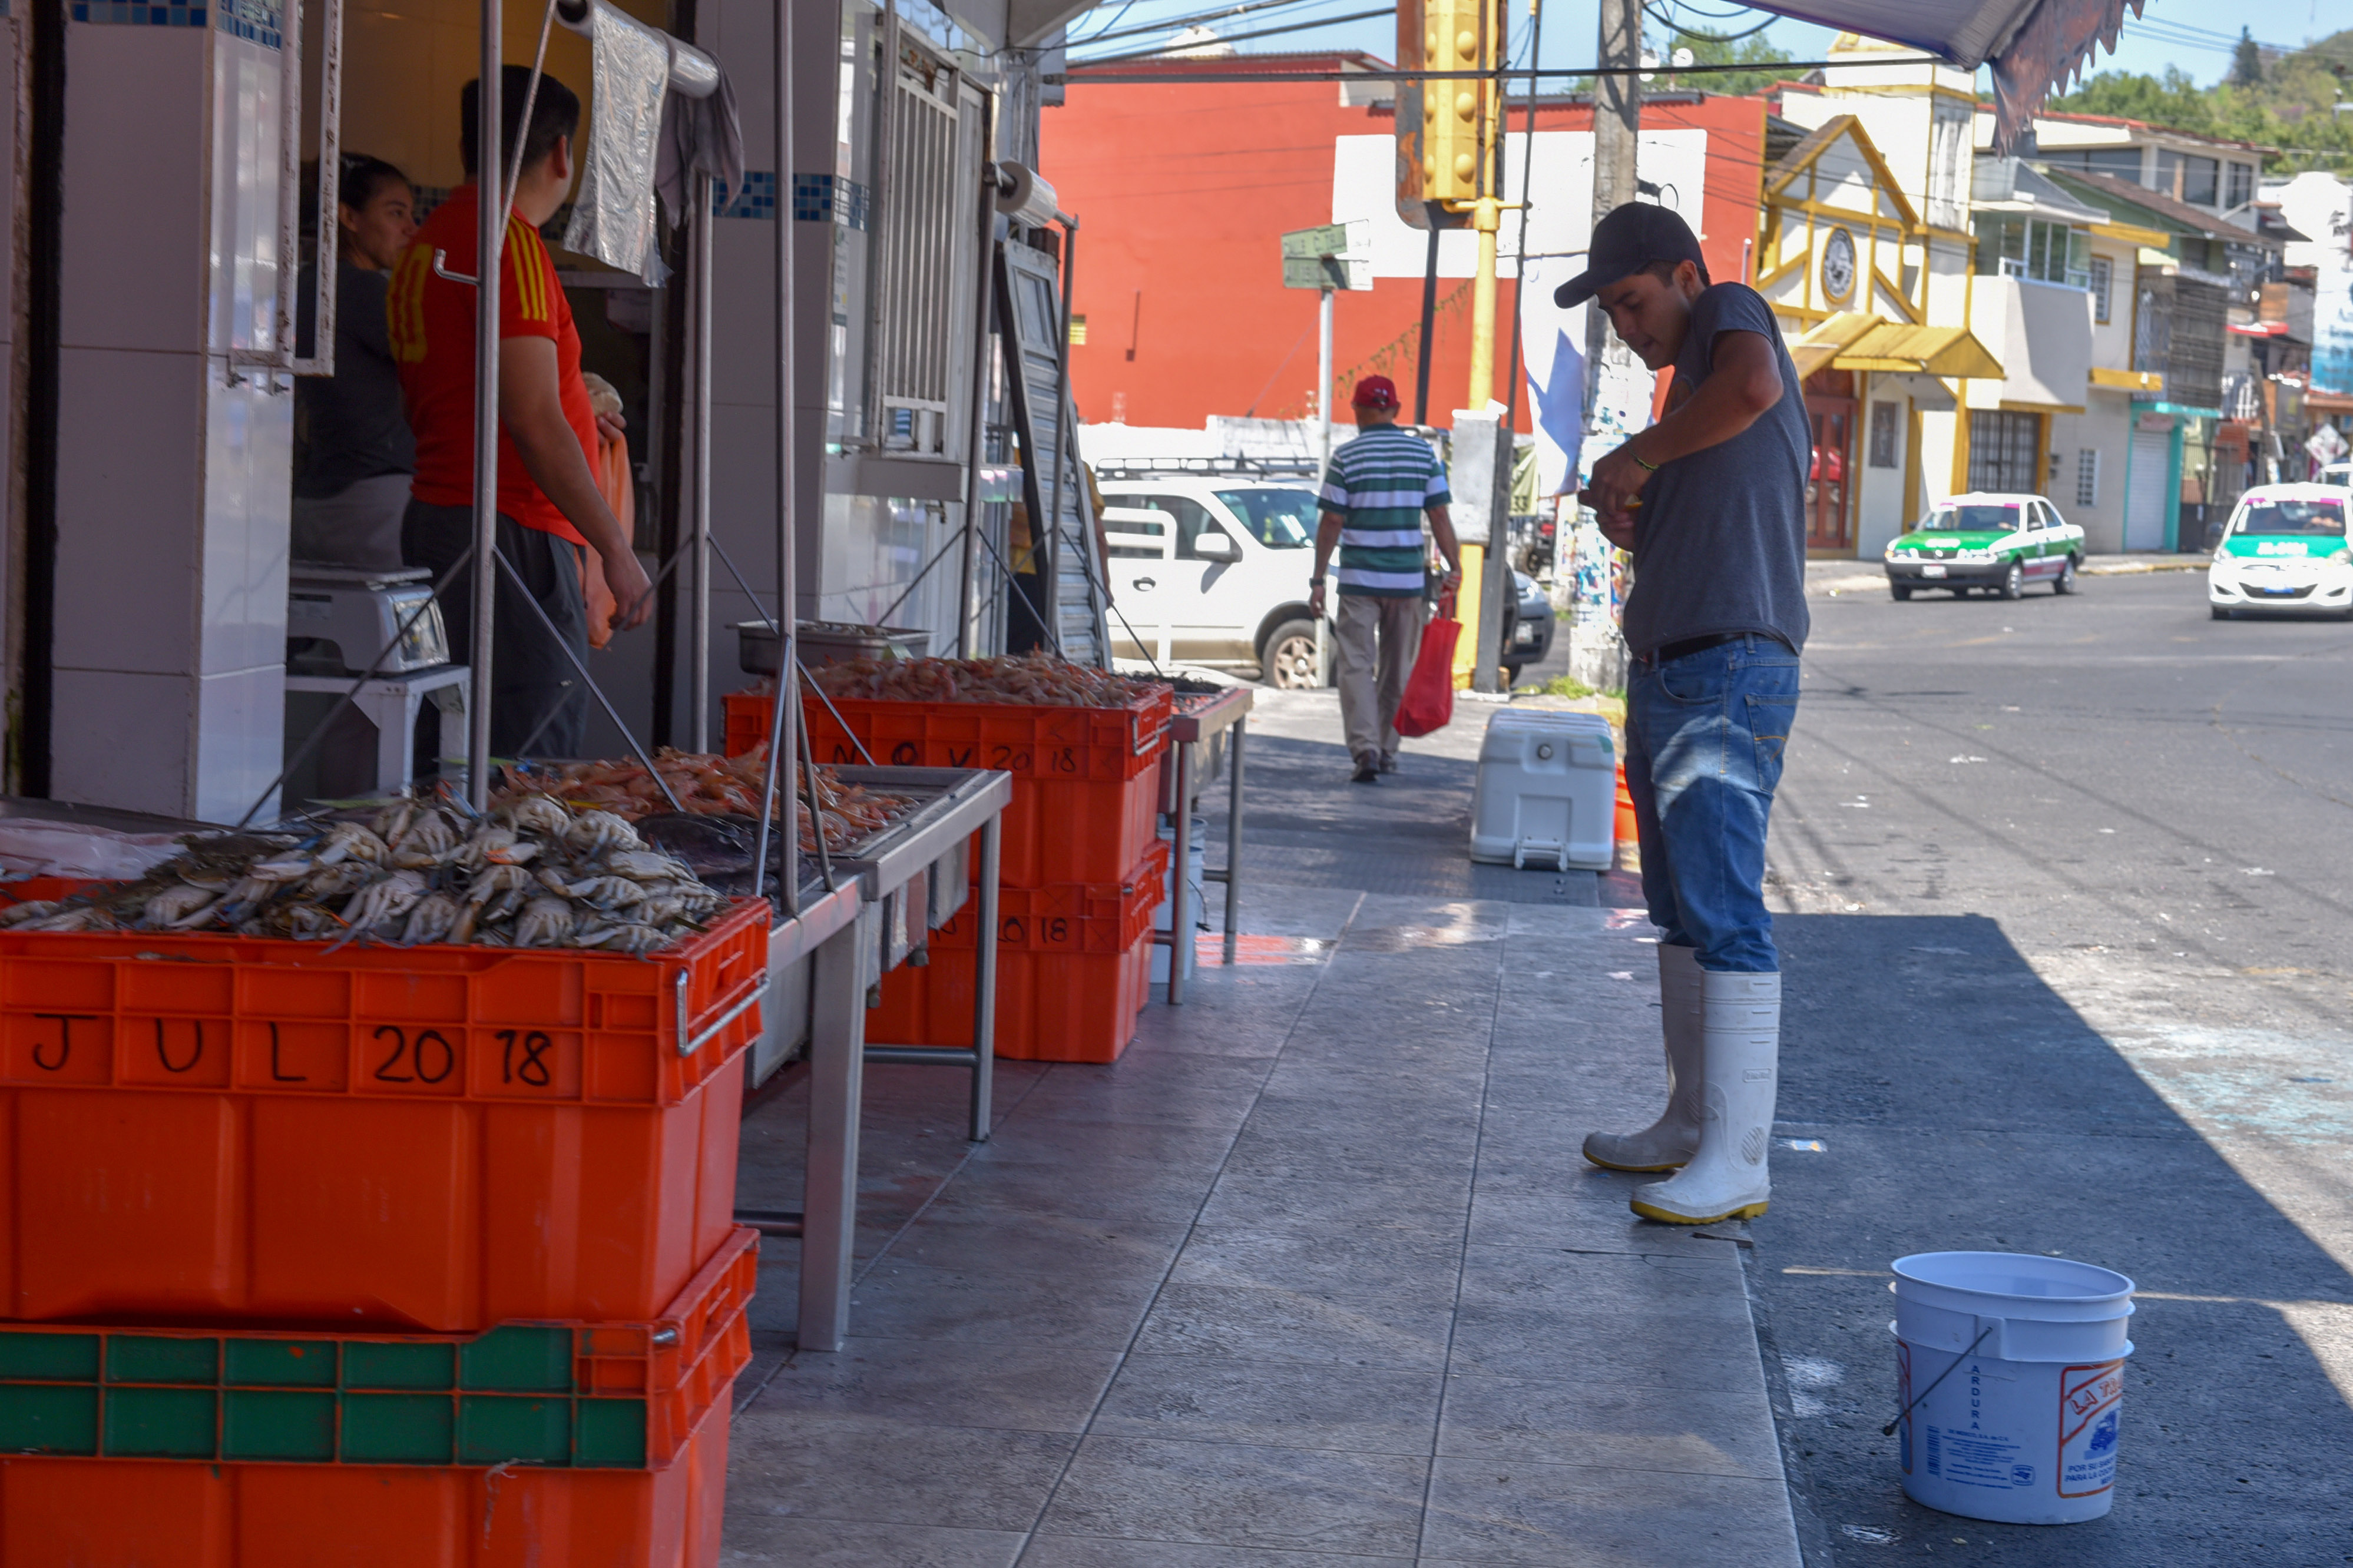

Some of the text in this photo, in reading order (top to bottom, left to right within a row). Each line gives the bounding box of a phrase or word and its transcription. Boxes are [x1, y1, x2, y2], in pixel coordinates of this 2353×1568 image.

[992, 745, 1077, 773] 2018
[373, 1025, 553, 1087] 2018
[1970, 1364, 1981, 1431] ARDURA
[2070, 1389, 2099, 1415] LA
[2064, 1474, 2087, 1482] PARA
[2068, 1464, 2087, 1473] POR
